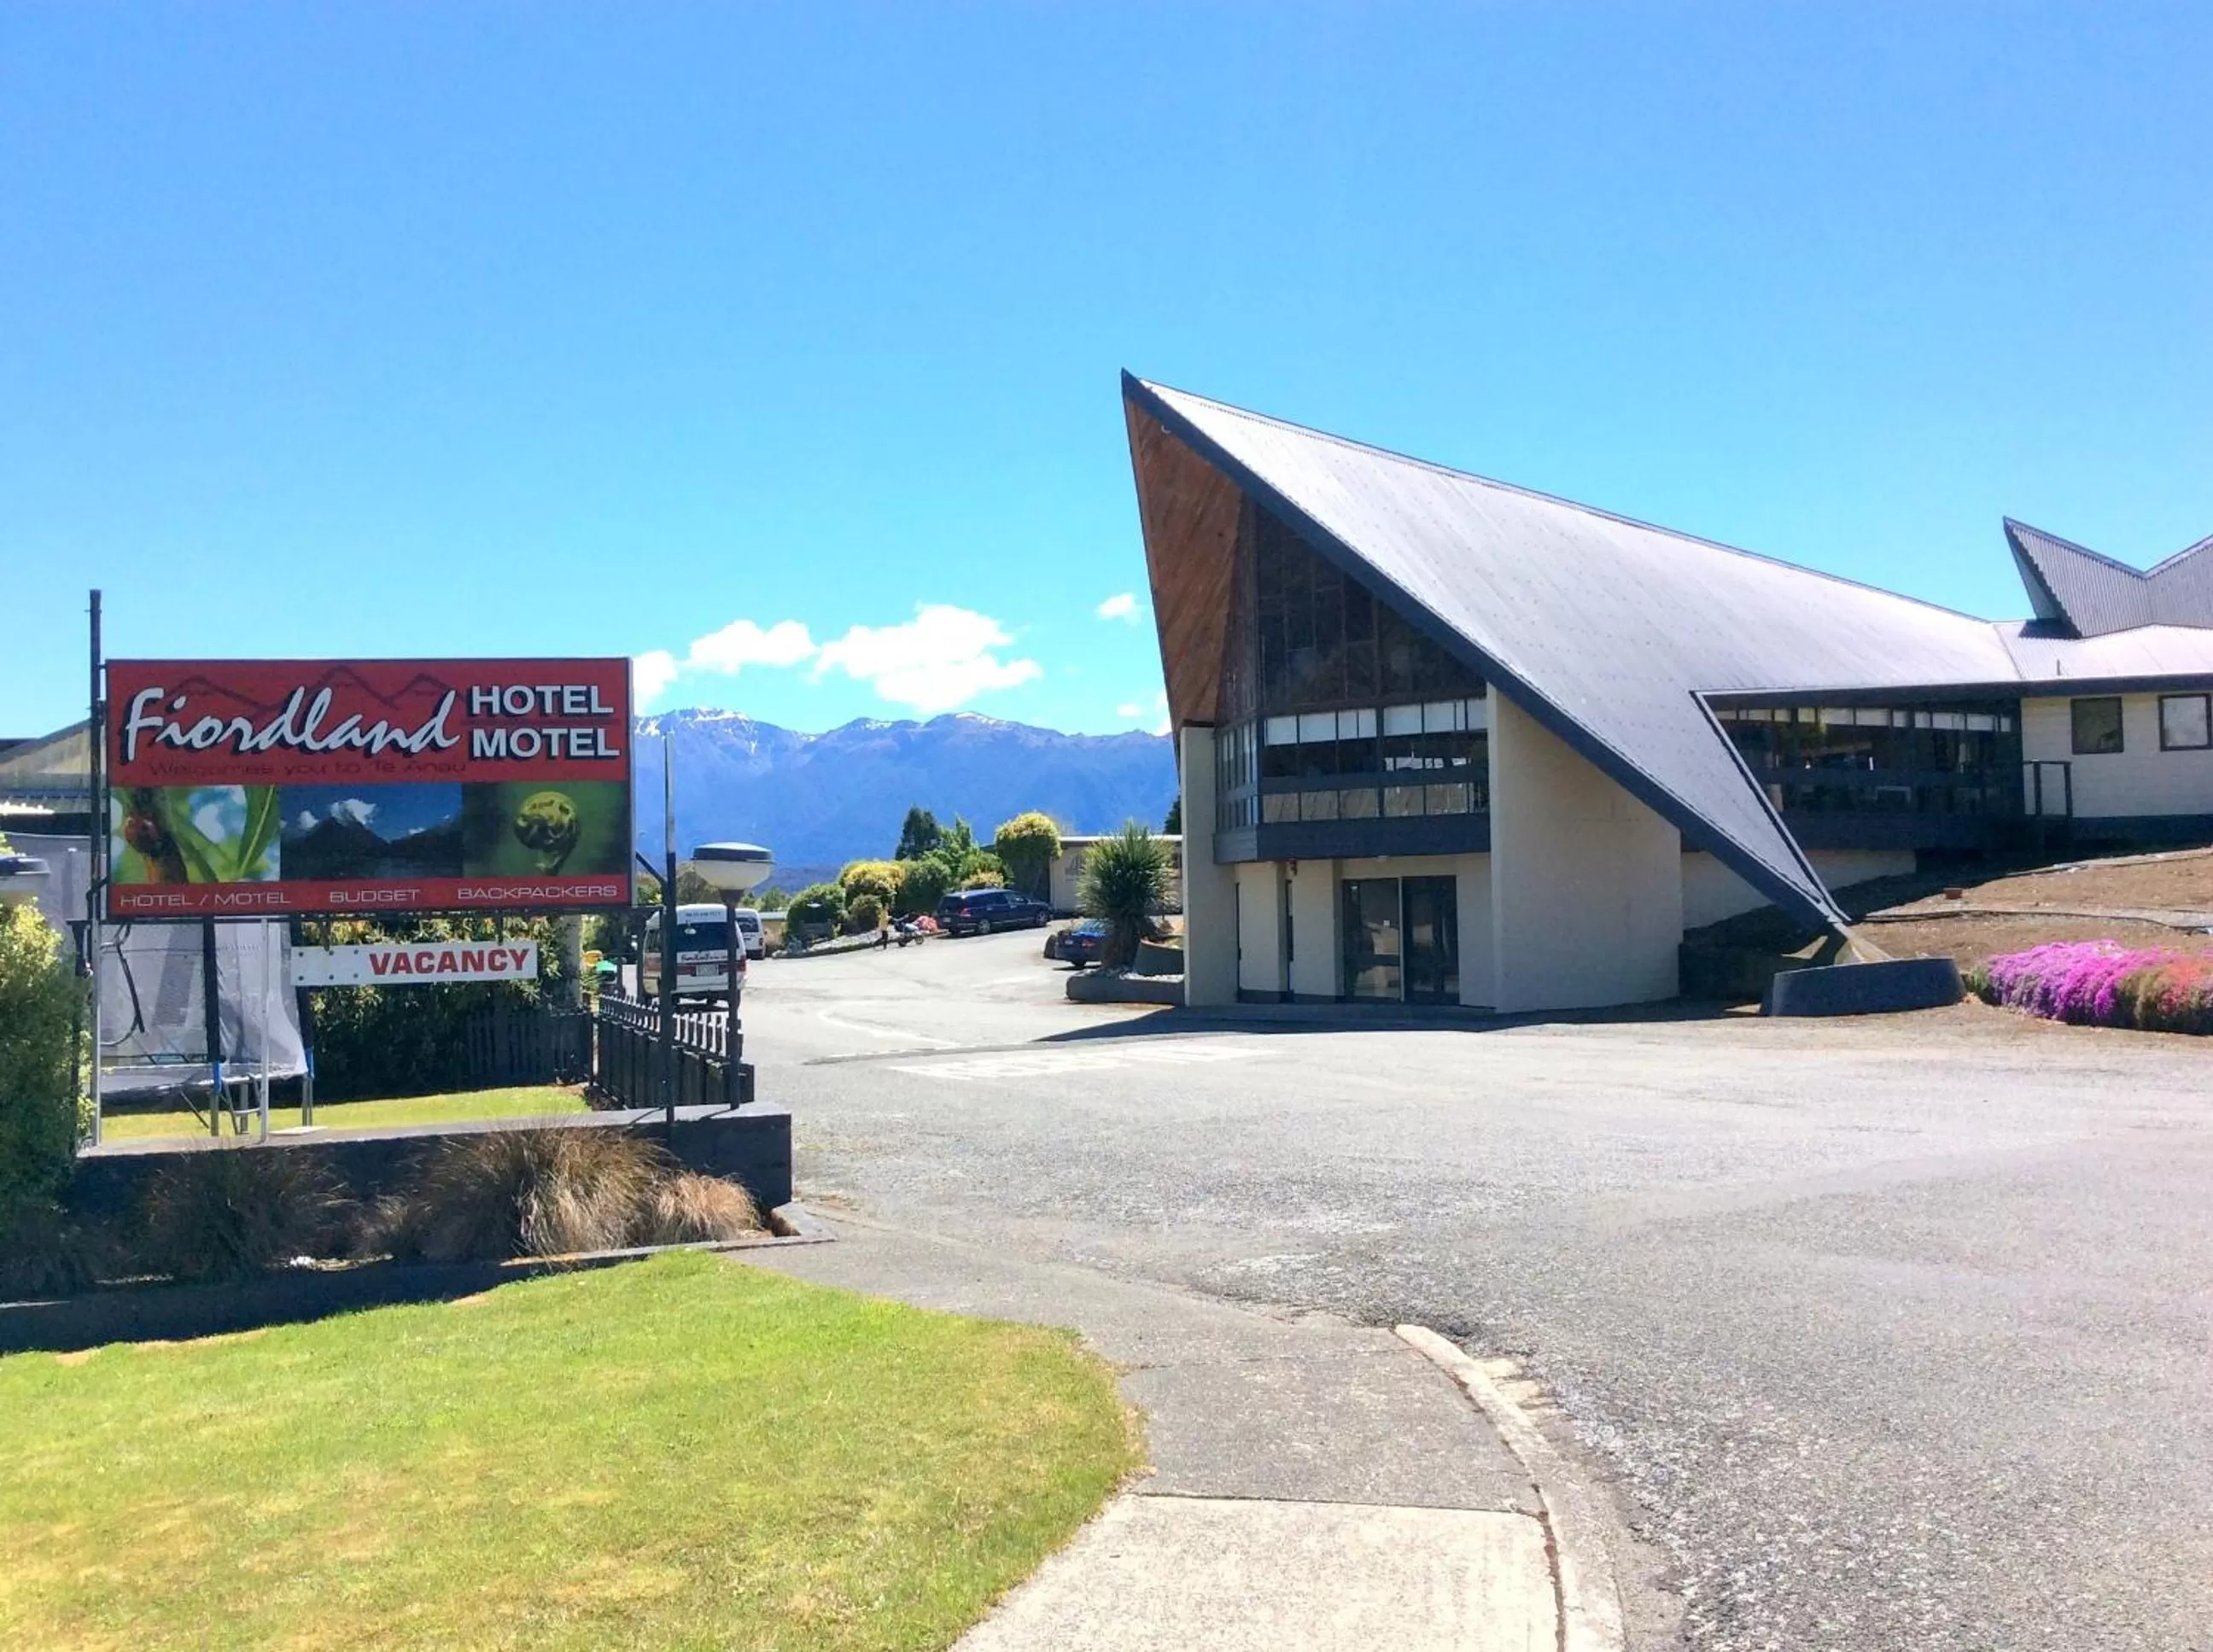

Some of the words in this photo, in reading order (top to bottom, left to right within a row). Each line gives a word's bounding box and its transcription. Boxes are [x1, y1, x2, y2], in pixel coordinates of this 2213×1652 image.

[472, 685, 615, 715] HOTEL
[125, 686, 462, 762] Fiordland
[472, 727, 621, 758] MOTEL
[120, 894, 193, 908] HOTEL
[213, 891, 293, 906] MOTEL
[330, 889, 420, 903] BUDGET
[458, 884, 618, 901] BACKPACKERS
[369, 949, 529, 976] VACANCY
